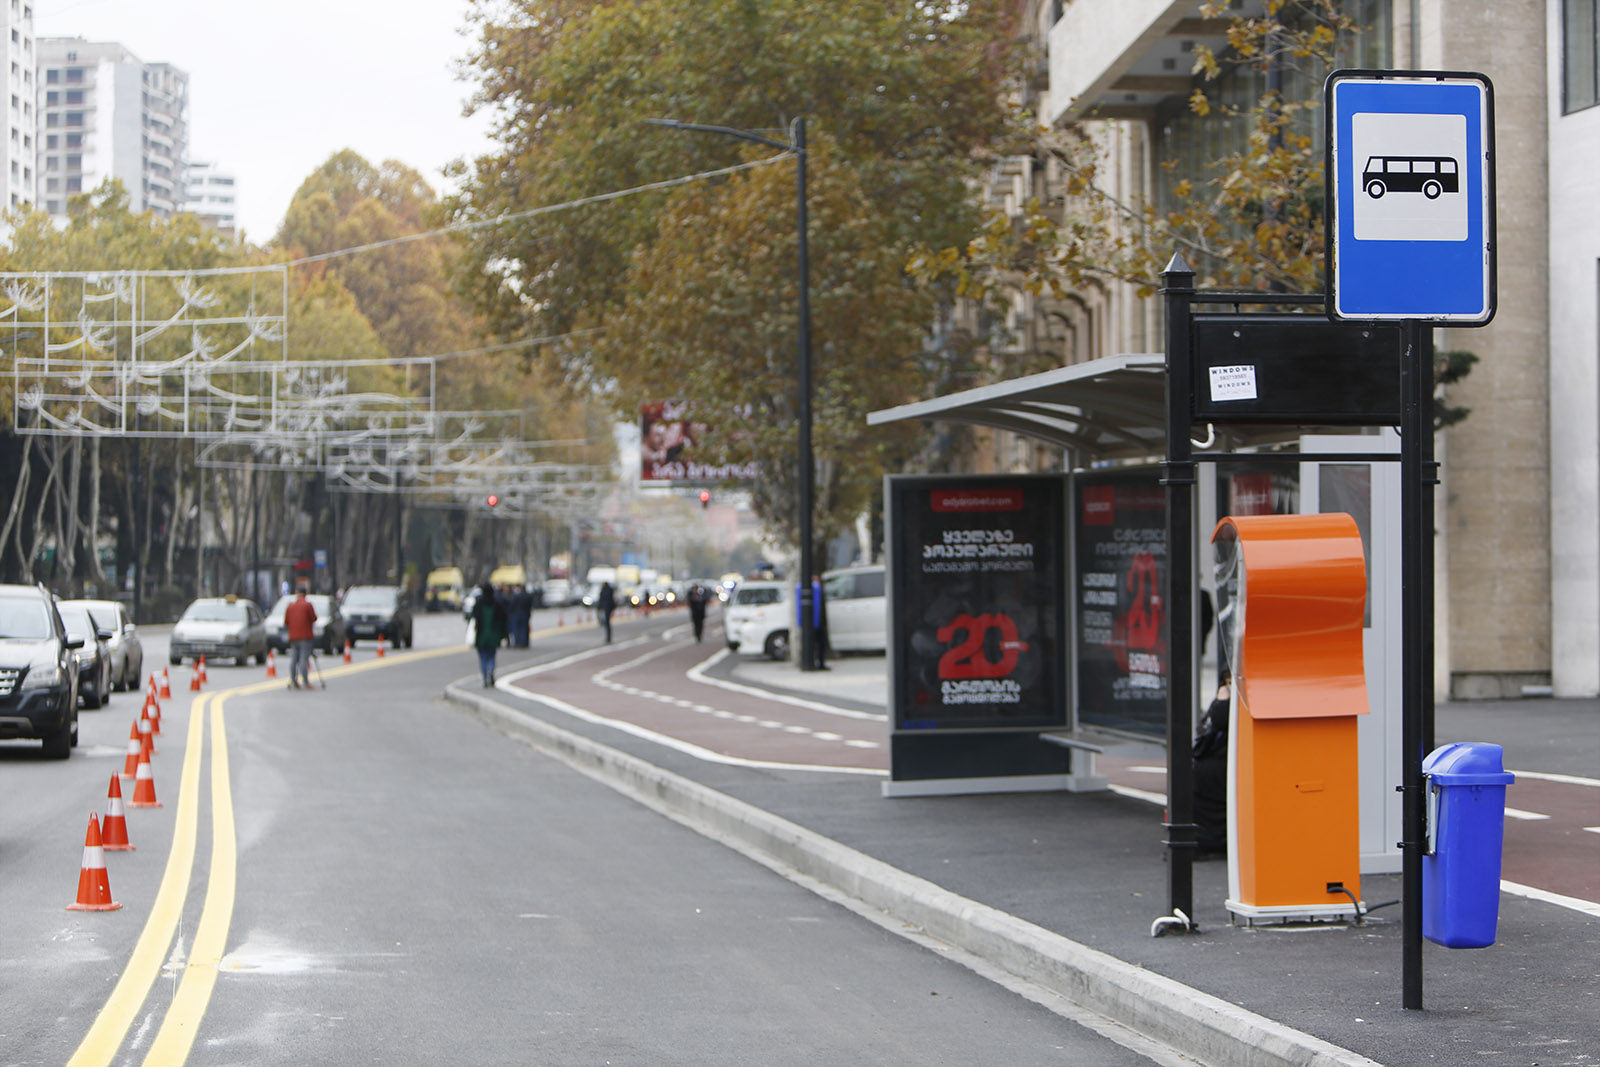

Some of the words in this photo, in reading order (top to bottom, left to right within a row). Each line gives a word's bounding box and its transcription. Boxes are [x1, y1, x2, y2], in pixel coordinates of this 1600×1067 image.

[1211, 366, 1254, 374] WINDOWS
[942, 529, 1014, 543] ყველაზე
[922, 543, 1034, 558] პოპულარული
[937, 612, 1019, 678] 20
